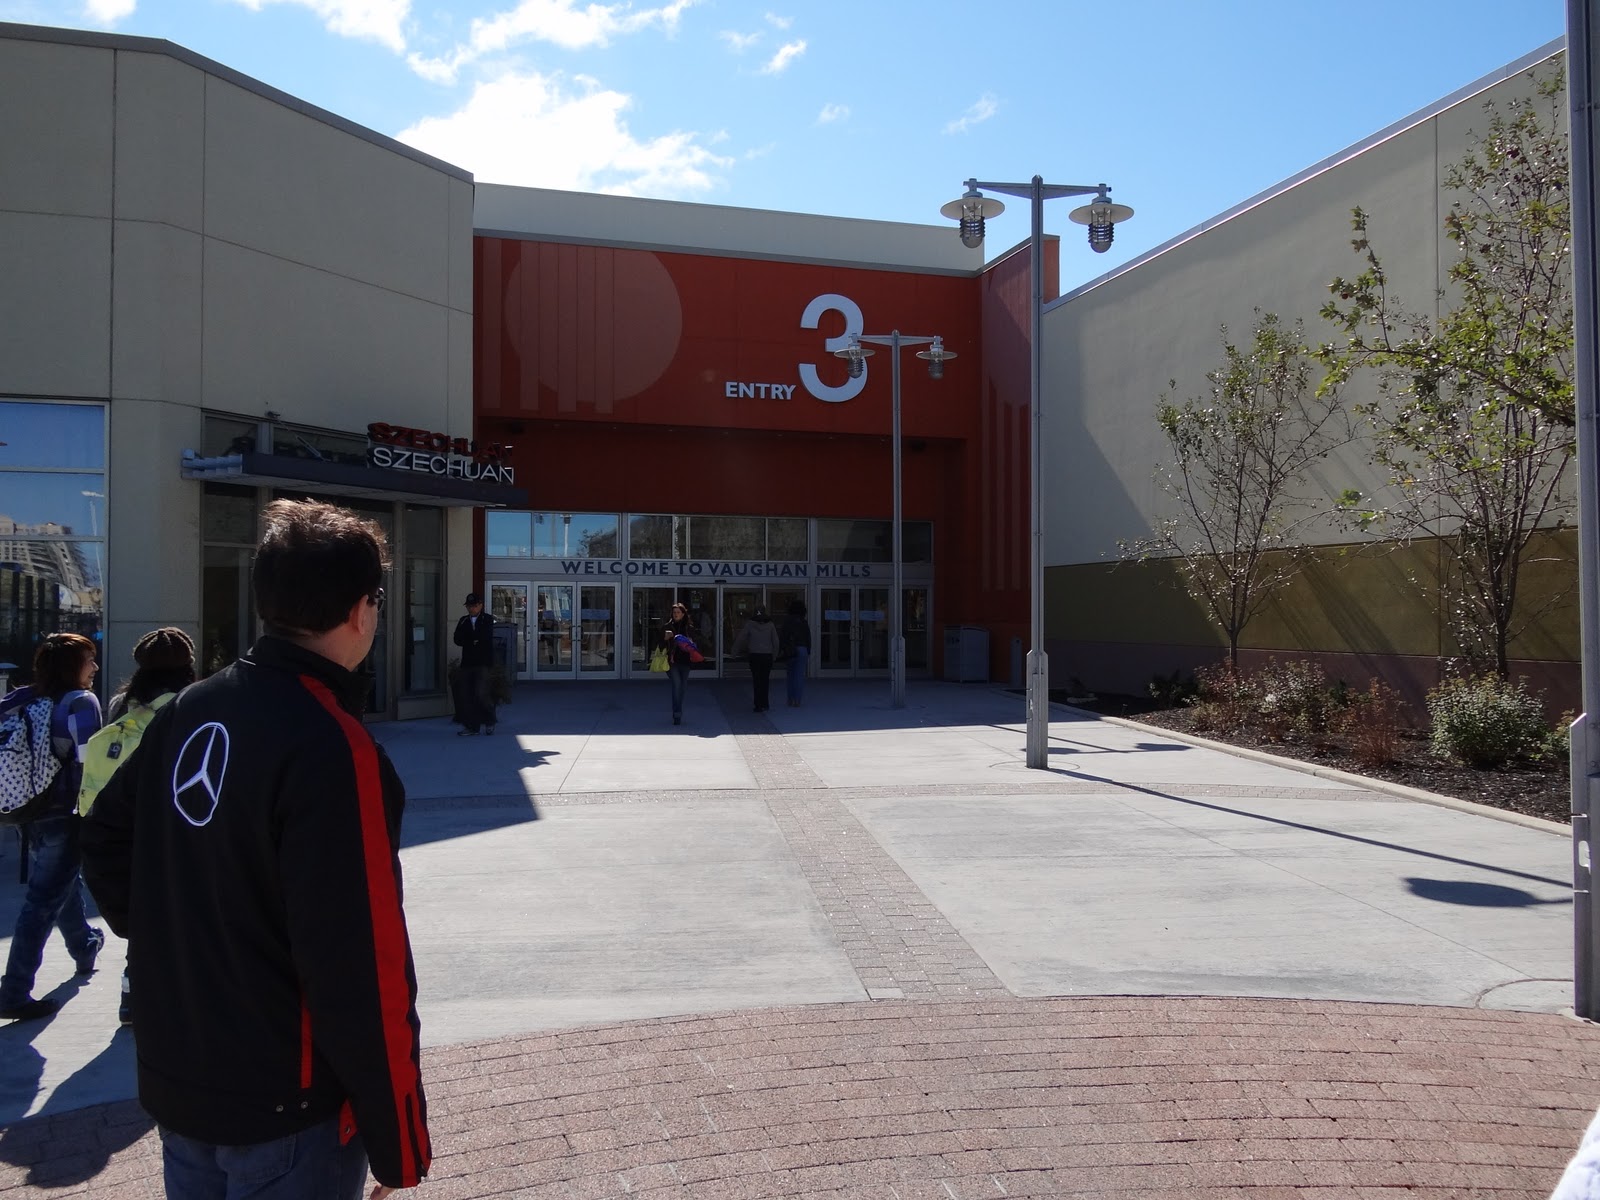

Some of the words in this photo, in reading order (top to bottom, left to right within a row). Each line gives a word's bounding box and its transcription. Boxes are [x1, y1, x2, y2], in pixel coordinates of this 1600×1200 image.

[725, 381, 796, 400] ENTRY
[798, 293, 868, 403] 3
[373, 447, 514, 485] SZECHUAN
[561, 561, 669, 575] WELCOME
[675, 562, 703, 575] TO
[707, 563, 808, 577] VAUGHAN
[816, 564, 871, 577] MILLS
